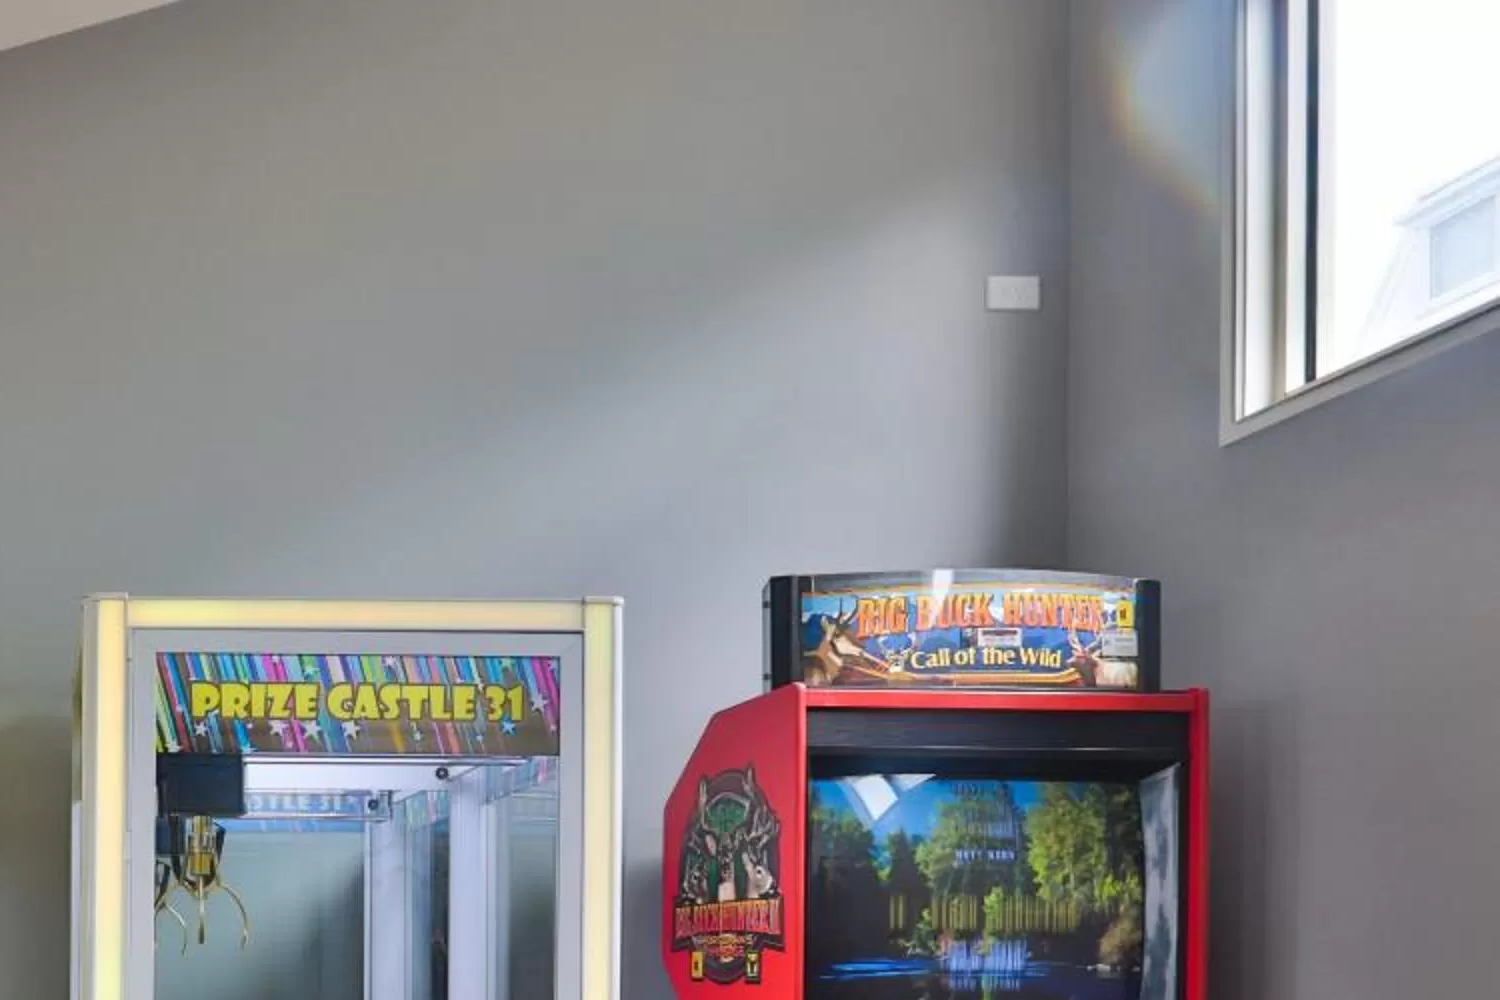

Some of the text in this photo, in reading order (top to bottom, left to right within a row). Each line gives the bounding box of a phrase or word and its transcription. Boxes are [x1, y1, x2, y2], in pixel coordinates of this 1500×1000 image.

[857, 591, 1102, 640] BIG BUCK HUNTER
[911, 647, 1062, 669] Call of the Wild
[190, 681, 526, 722] PRIZE CASTLE 31
